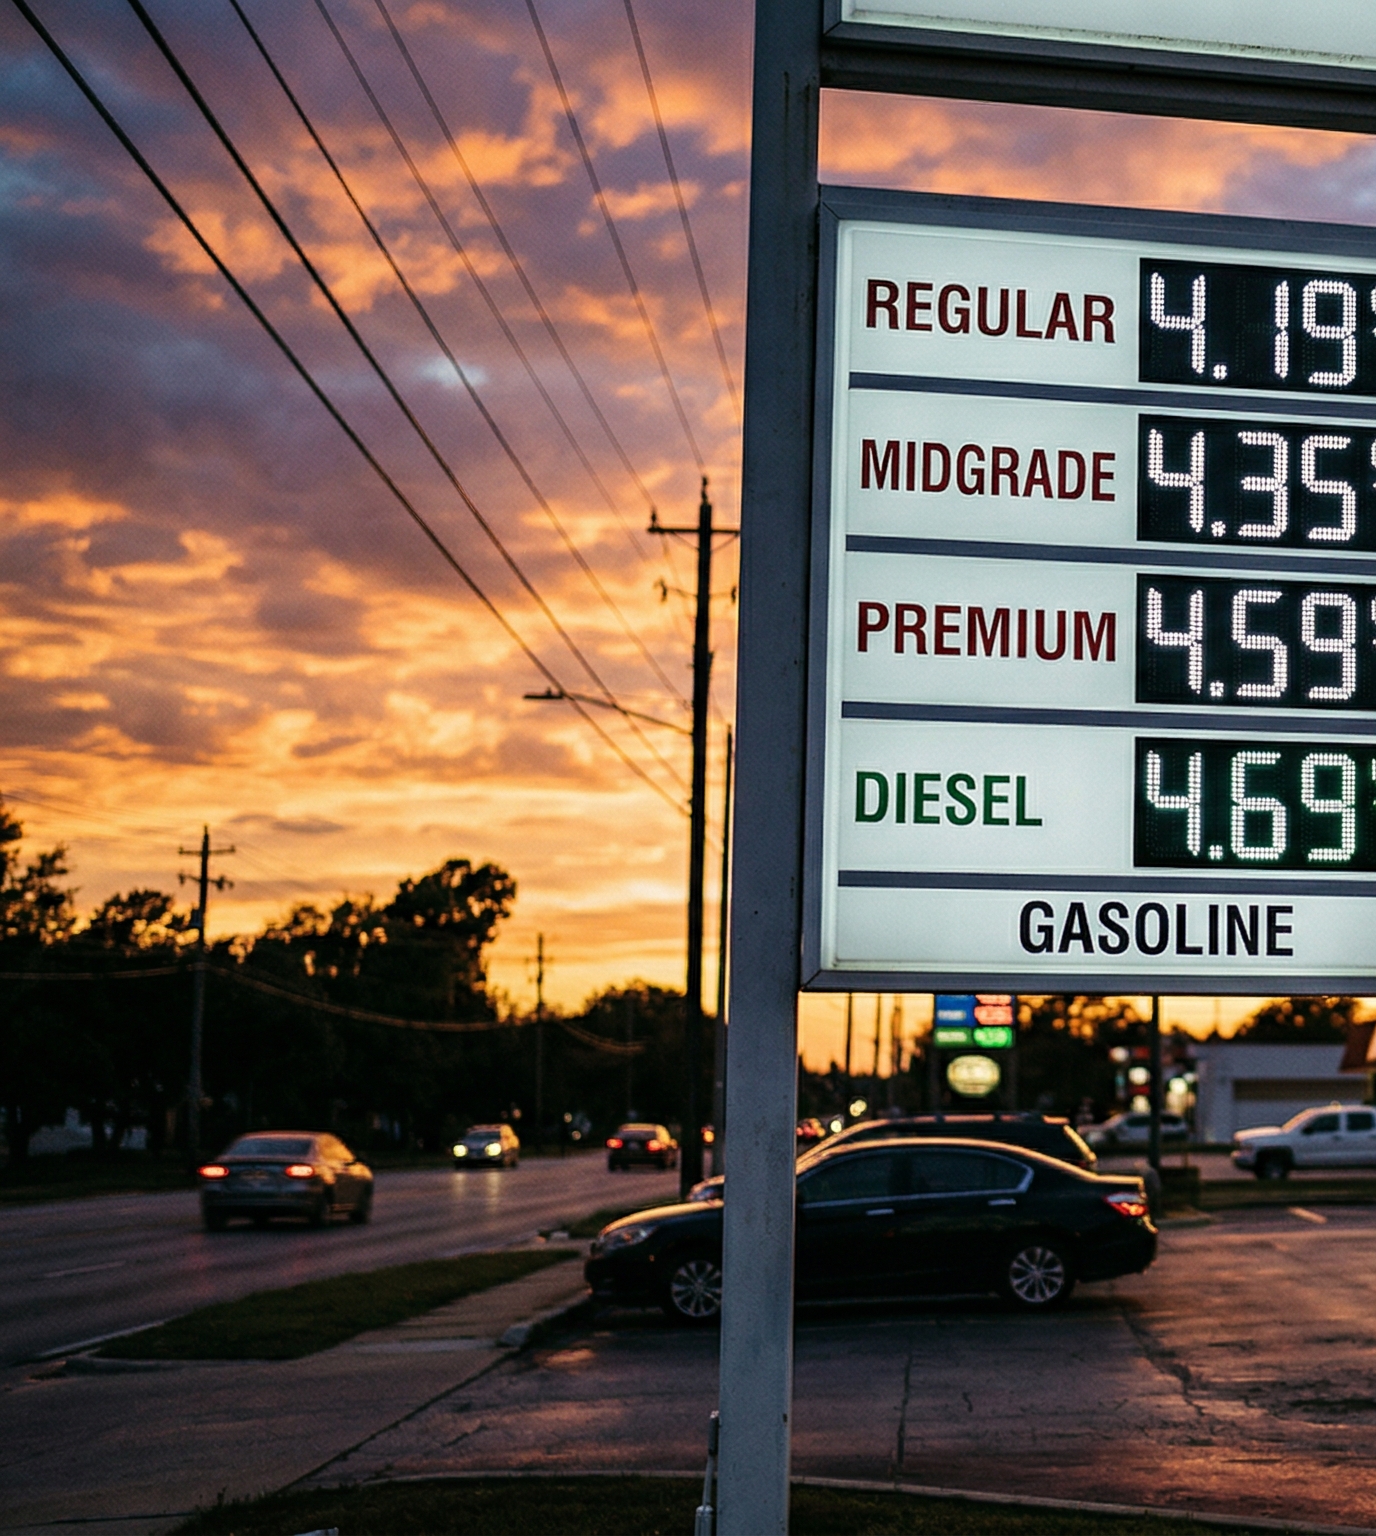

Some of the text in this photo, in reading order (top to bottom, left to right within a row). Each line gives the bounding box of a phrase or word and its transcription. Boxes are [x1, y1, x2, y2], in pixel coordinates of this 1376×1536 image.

[866, 279, 1116, 343] REGULAR
[1150, 272, 1357, 388] 4.19
[861, 439, 1116, 502] MIDGRADE
[1147, 428, 1357, 541] 4.35
[858, 601, 1117, 663] PREMIUM
[1145, 587, 1357, 700] 4.59
[855, 771, 1043, 827] DIESEL
[1146, 750, 1357, 861] 4.69
[1020, 901, 1294, 957] GASOLINE
